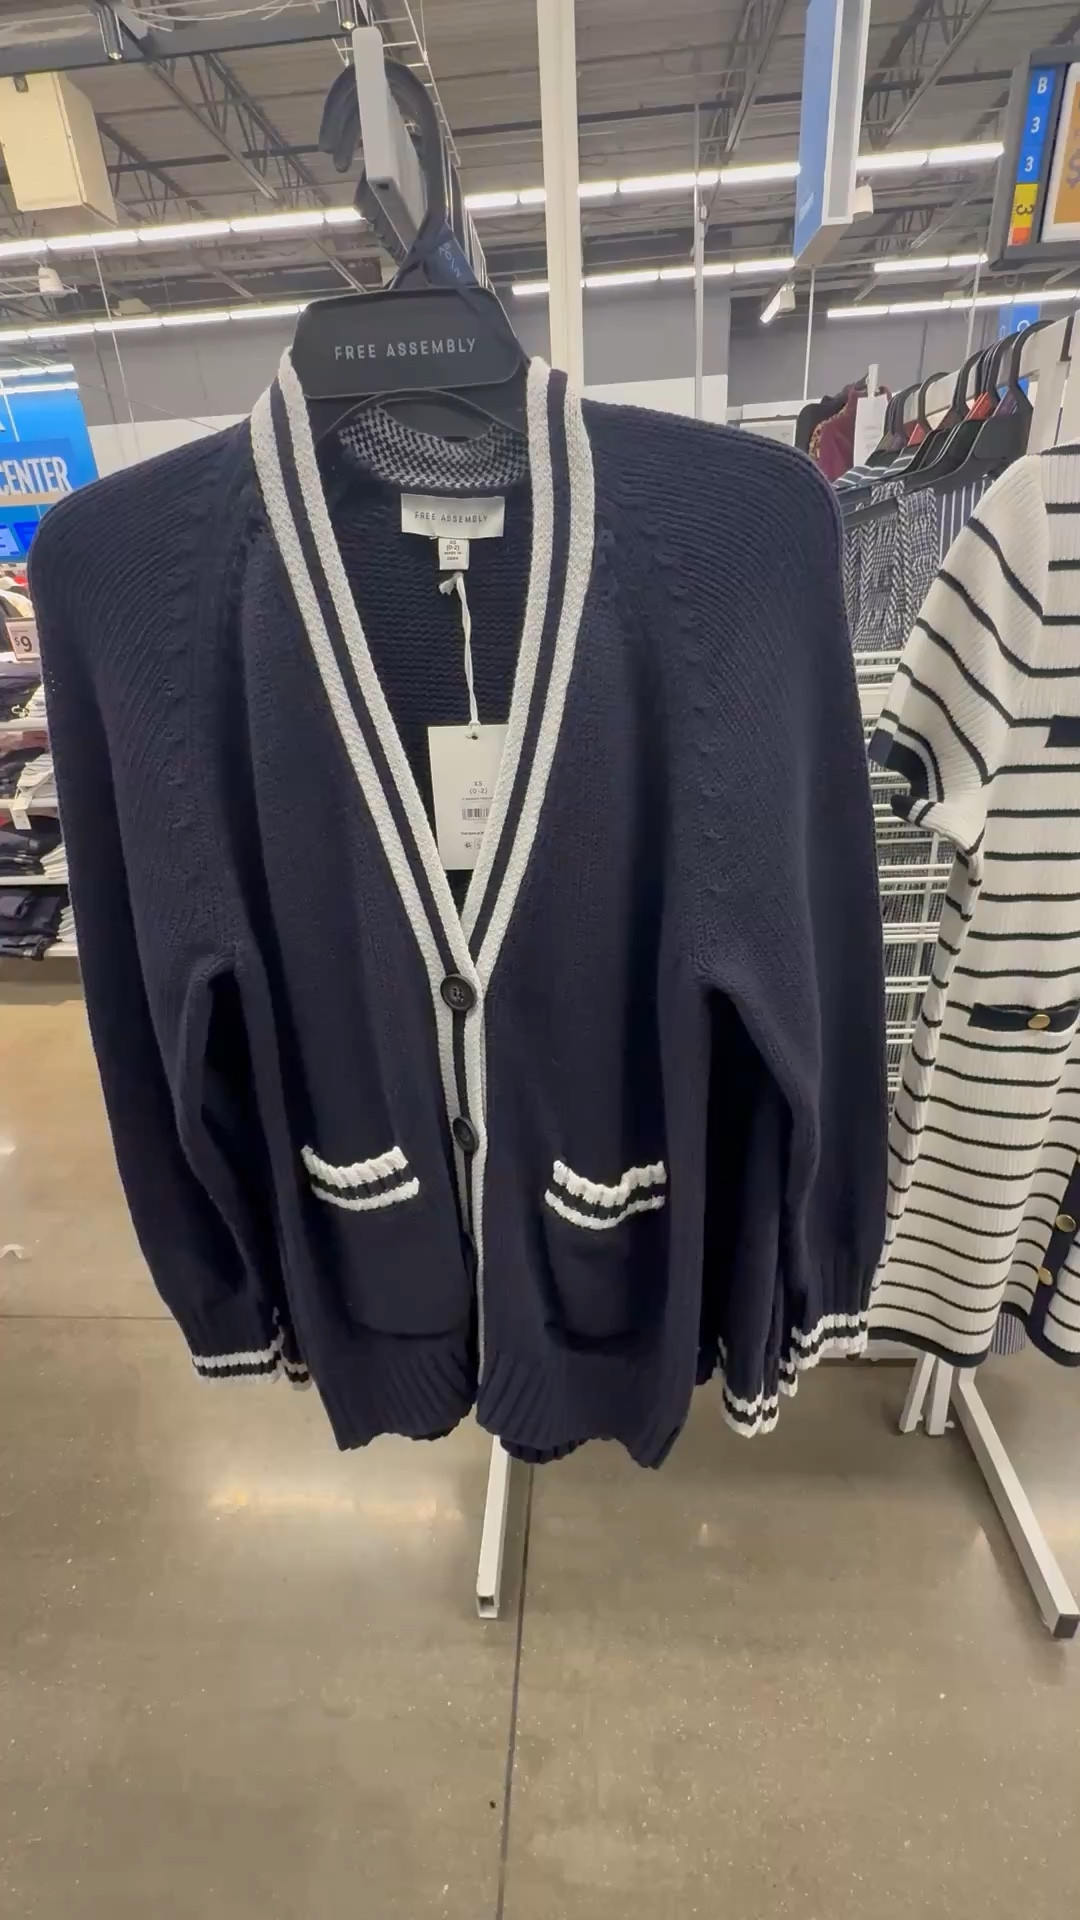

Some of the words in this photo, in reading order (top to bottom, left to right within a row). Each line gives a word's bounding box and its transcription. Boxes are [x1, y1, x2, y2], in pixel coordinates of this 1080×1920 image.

[1037, 77, 1048, 94] B
[1031, 116, 1041, 133] 3
[1024, 156, 1034, 173] 3
[335, 344, 376, 361] FREE
[386, 338, 476, 357] ASSEMBLY
[414, 511, 436, 521] FREE
[440, 514, 488, 523] ASSEMBLY
[470, 787, 488, 795] (0-2)
